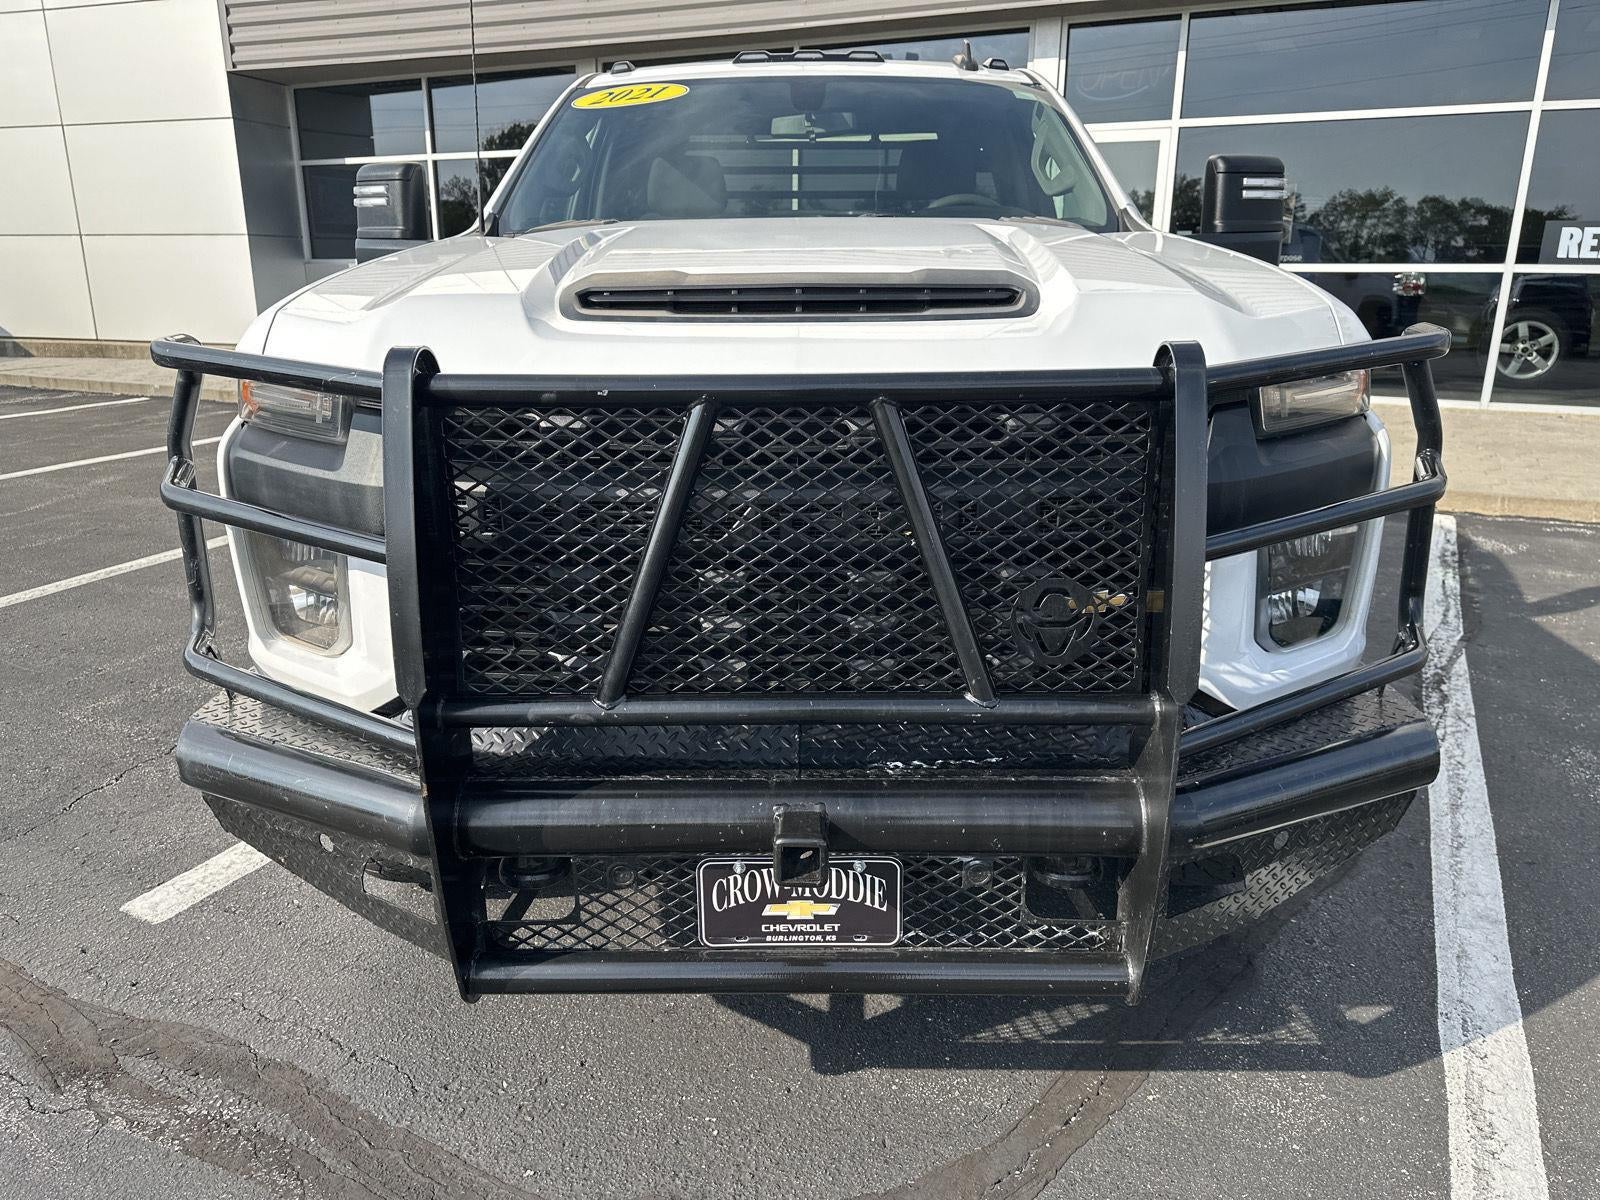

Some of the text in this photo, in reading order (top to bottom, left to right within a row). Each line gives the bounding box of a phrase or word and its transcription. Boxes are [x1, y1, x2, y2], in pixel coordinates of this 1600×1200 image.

[587, 86, 670, 105] 2021
[1556, 226, 1600, 259] RE
[761, 923, 841, 932] CHEVROLET
[765, 935, 823, 943] BURLINGTON,
